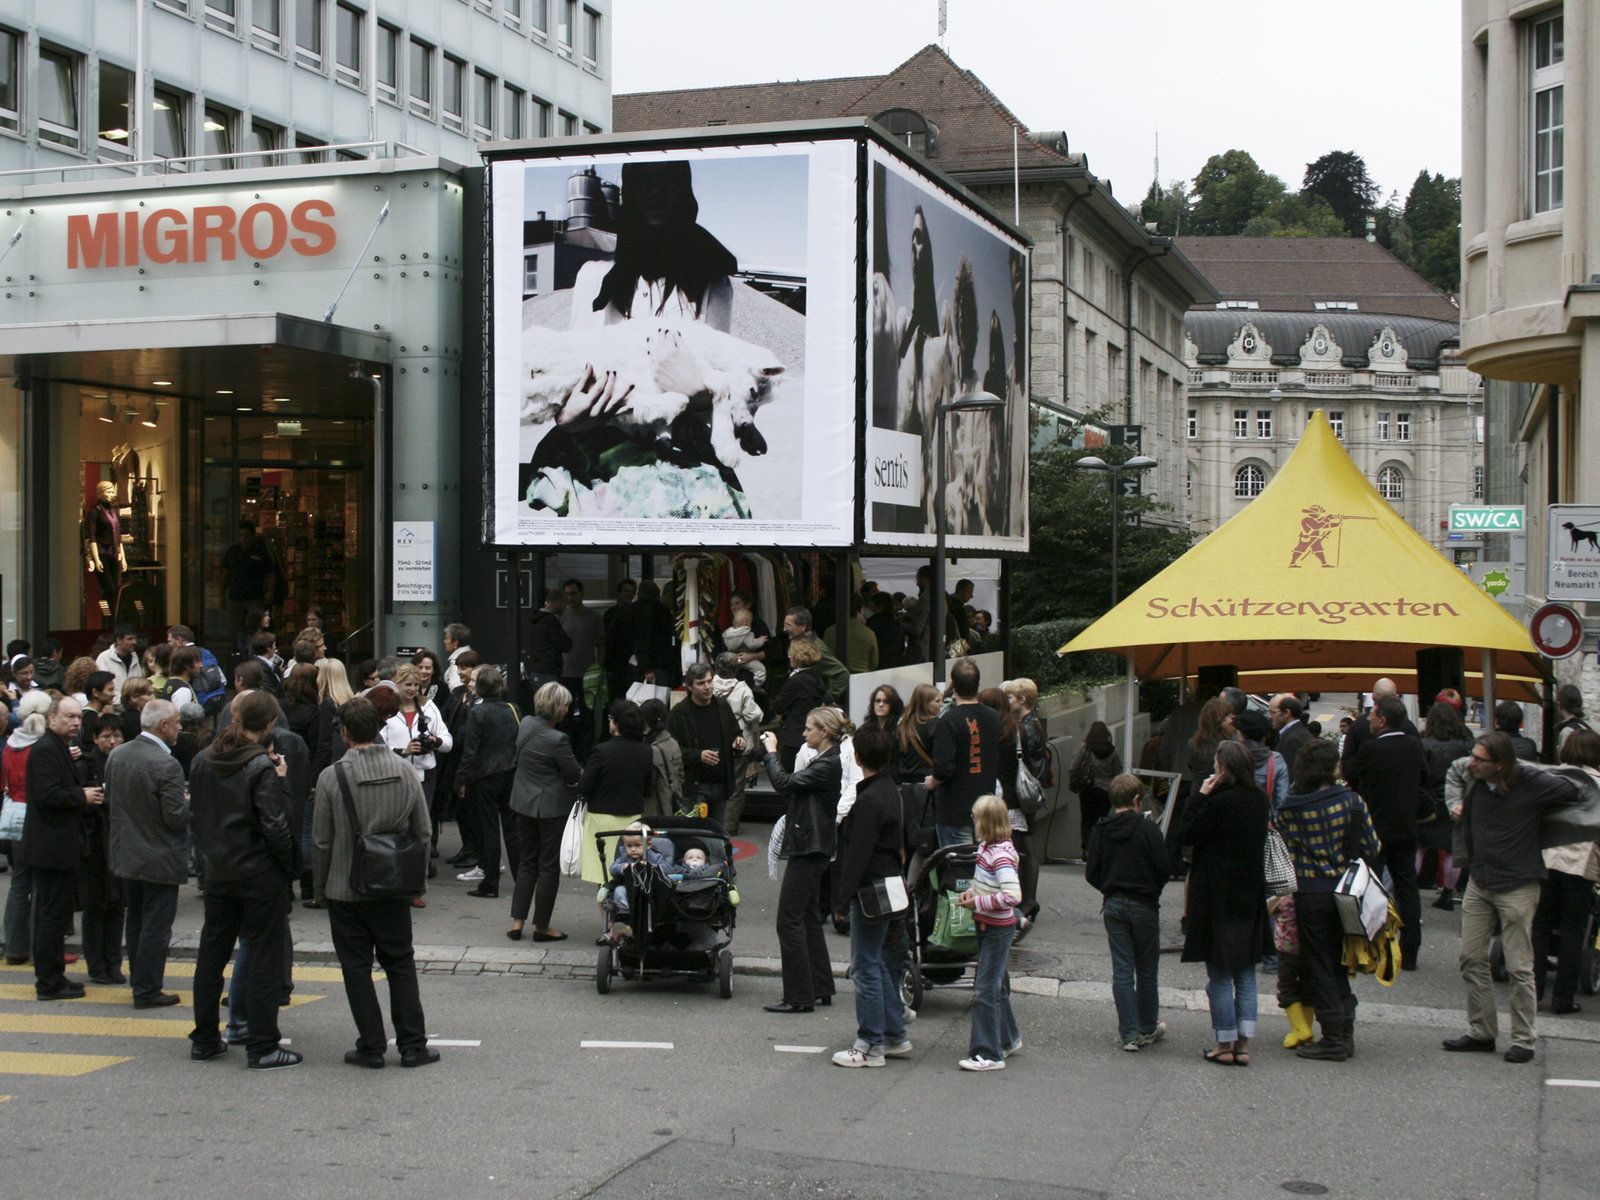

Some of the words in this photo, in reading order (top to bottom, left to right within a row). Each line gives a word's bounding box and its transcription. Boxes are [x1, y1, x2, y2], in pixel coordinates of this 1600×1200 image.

[67, 199, 337, 269] MIGROS
[874, 453, 908, 489] sentis
[1555, 580, 1595, 589] Neumarkt
[1568, 569, 1598, 578] Bereich
[1145, 596, 1462, 624] Schützengarten
